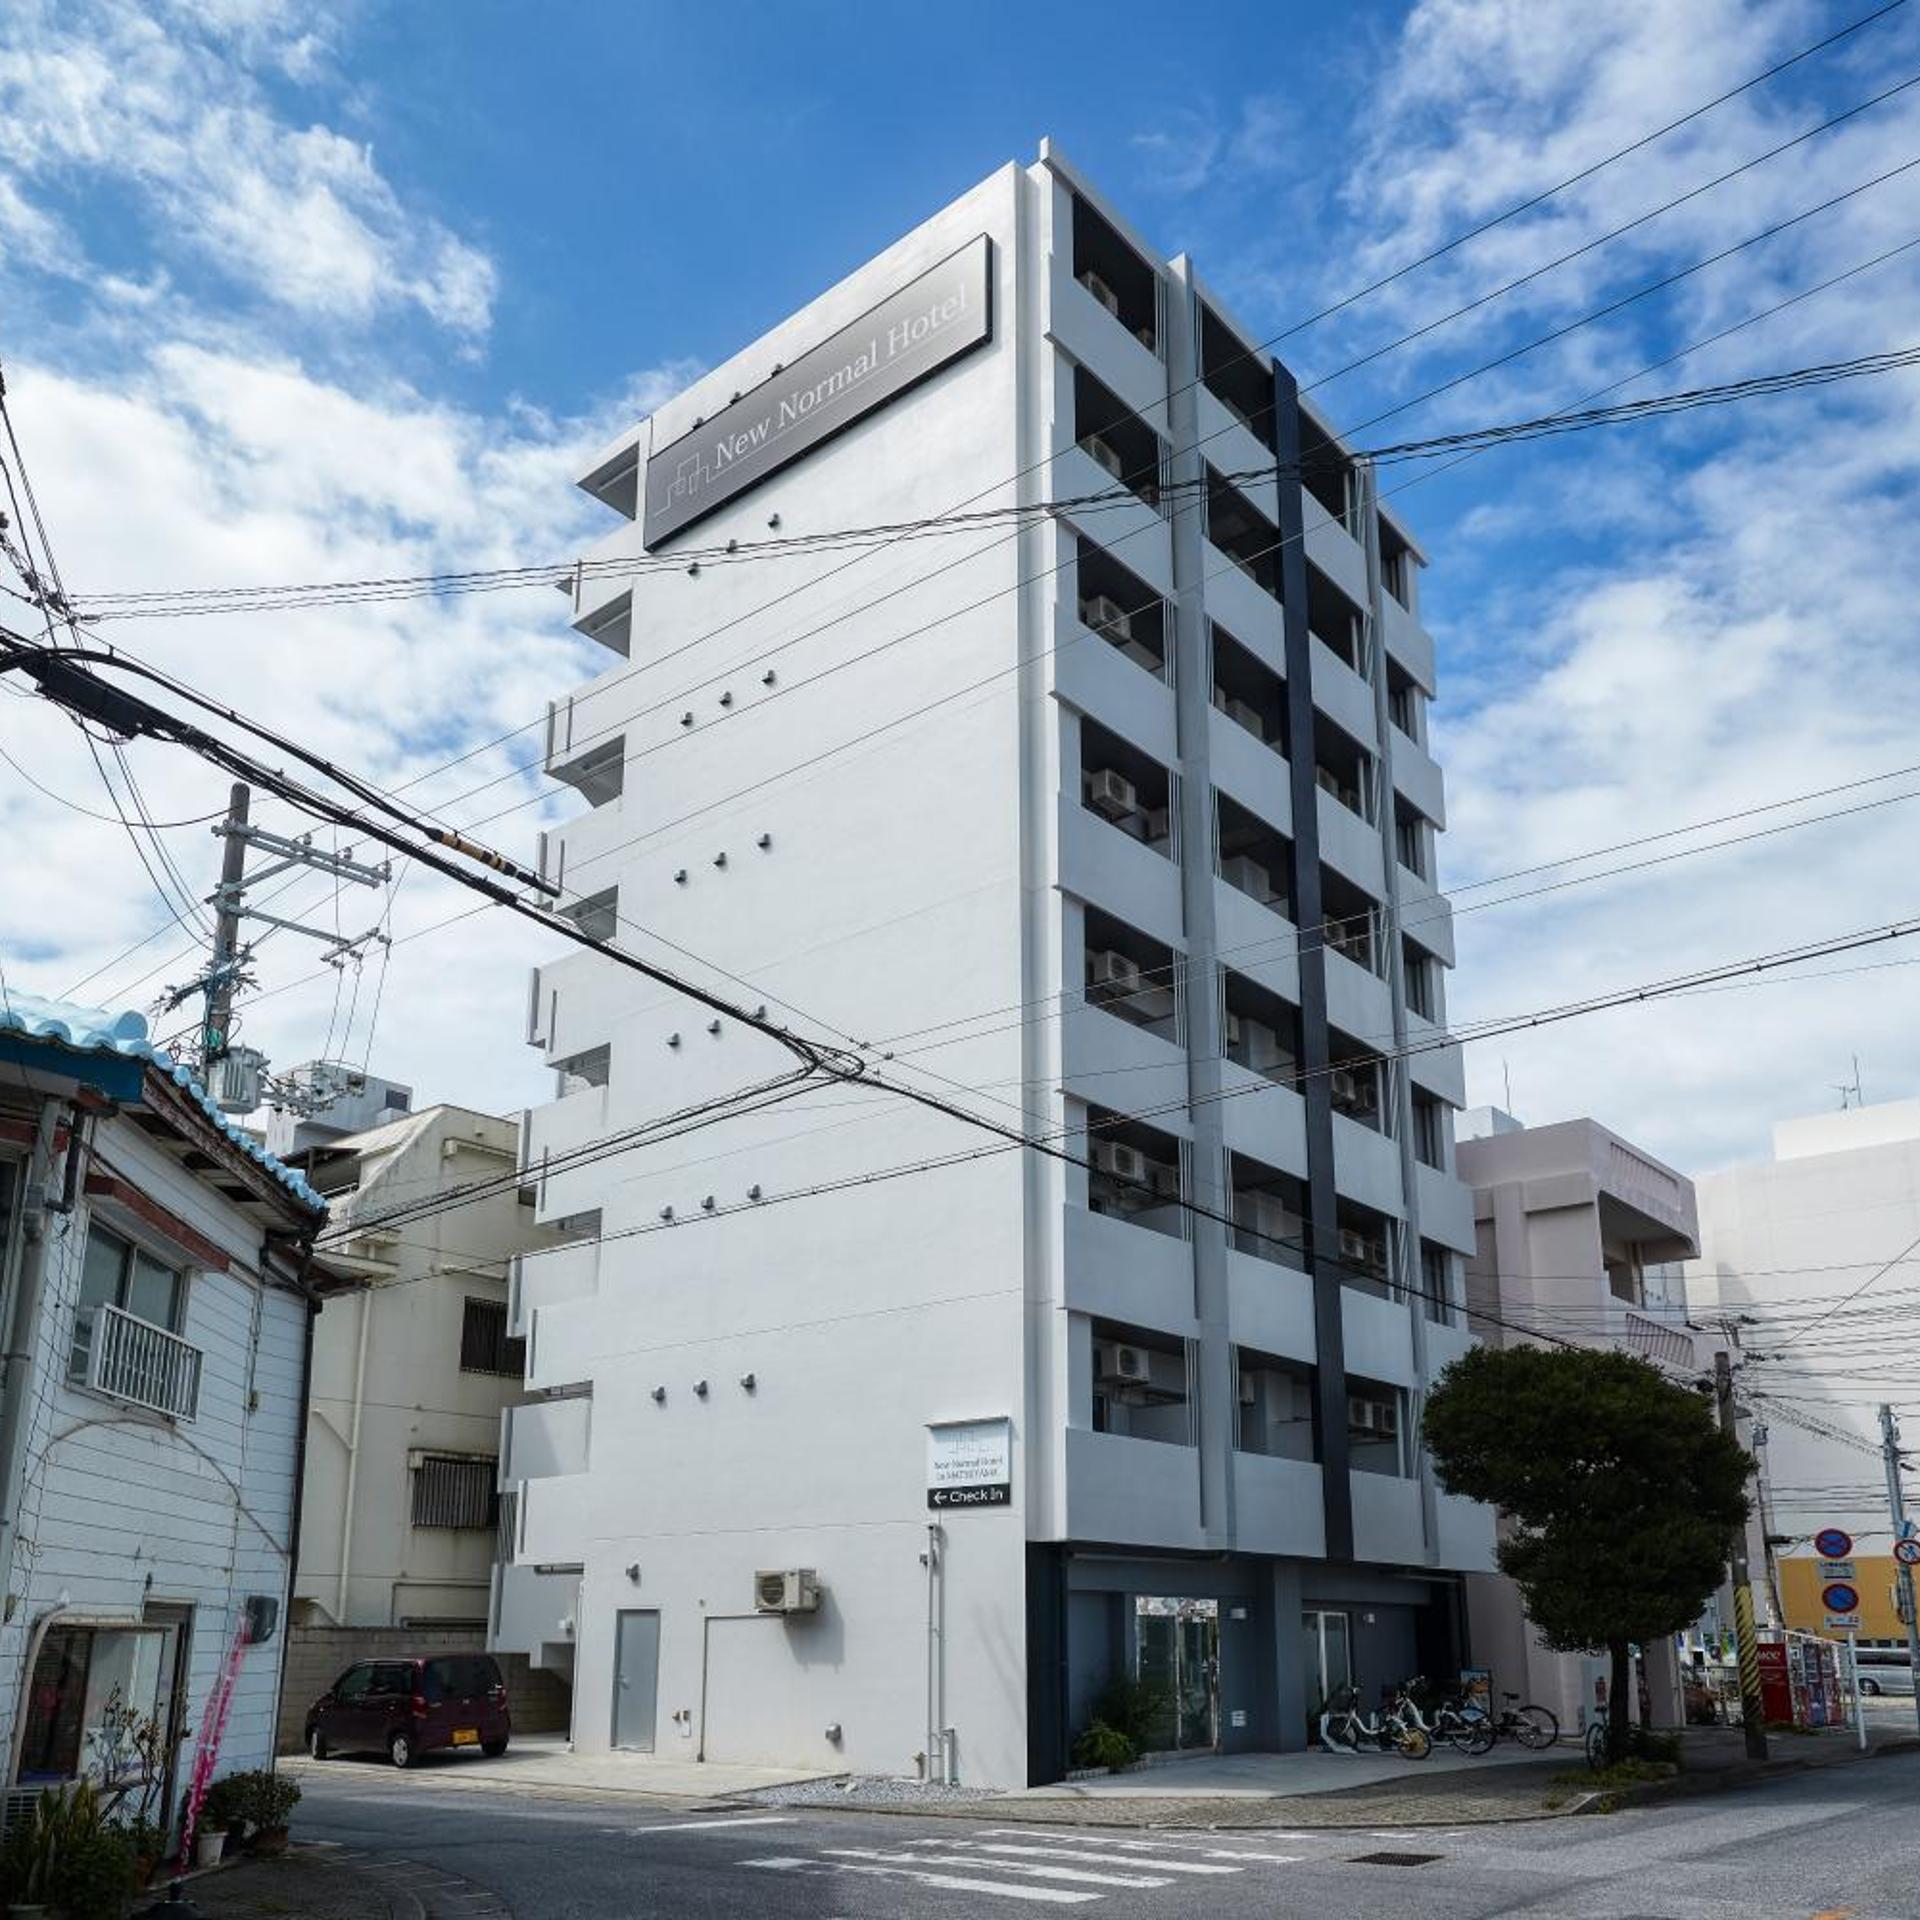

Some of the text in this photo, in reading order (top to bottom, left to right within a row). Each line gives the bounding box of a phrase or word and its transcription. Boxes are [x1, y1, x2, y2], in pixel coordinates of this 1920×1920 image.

[714, 283, 969, 470] New Normal Hotel
[950, 1489, 988, 1502] Check
